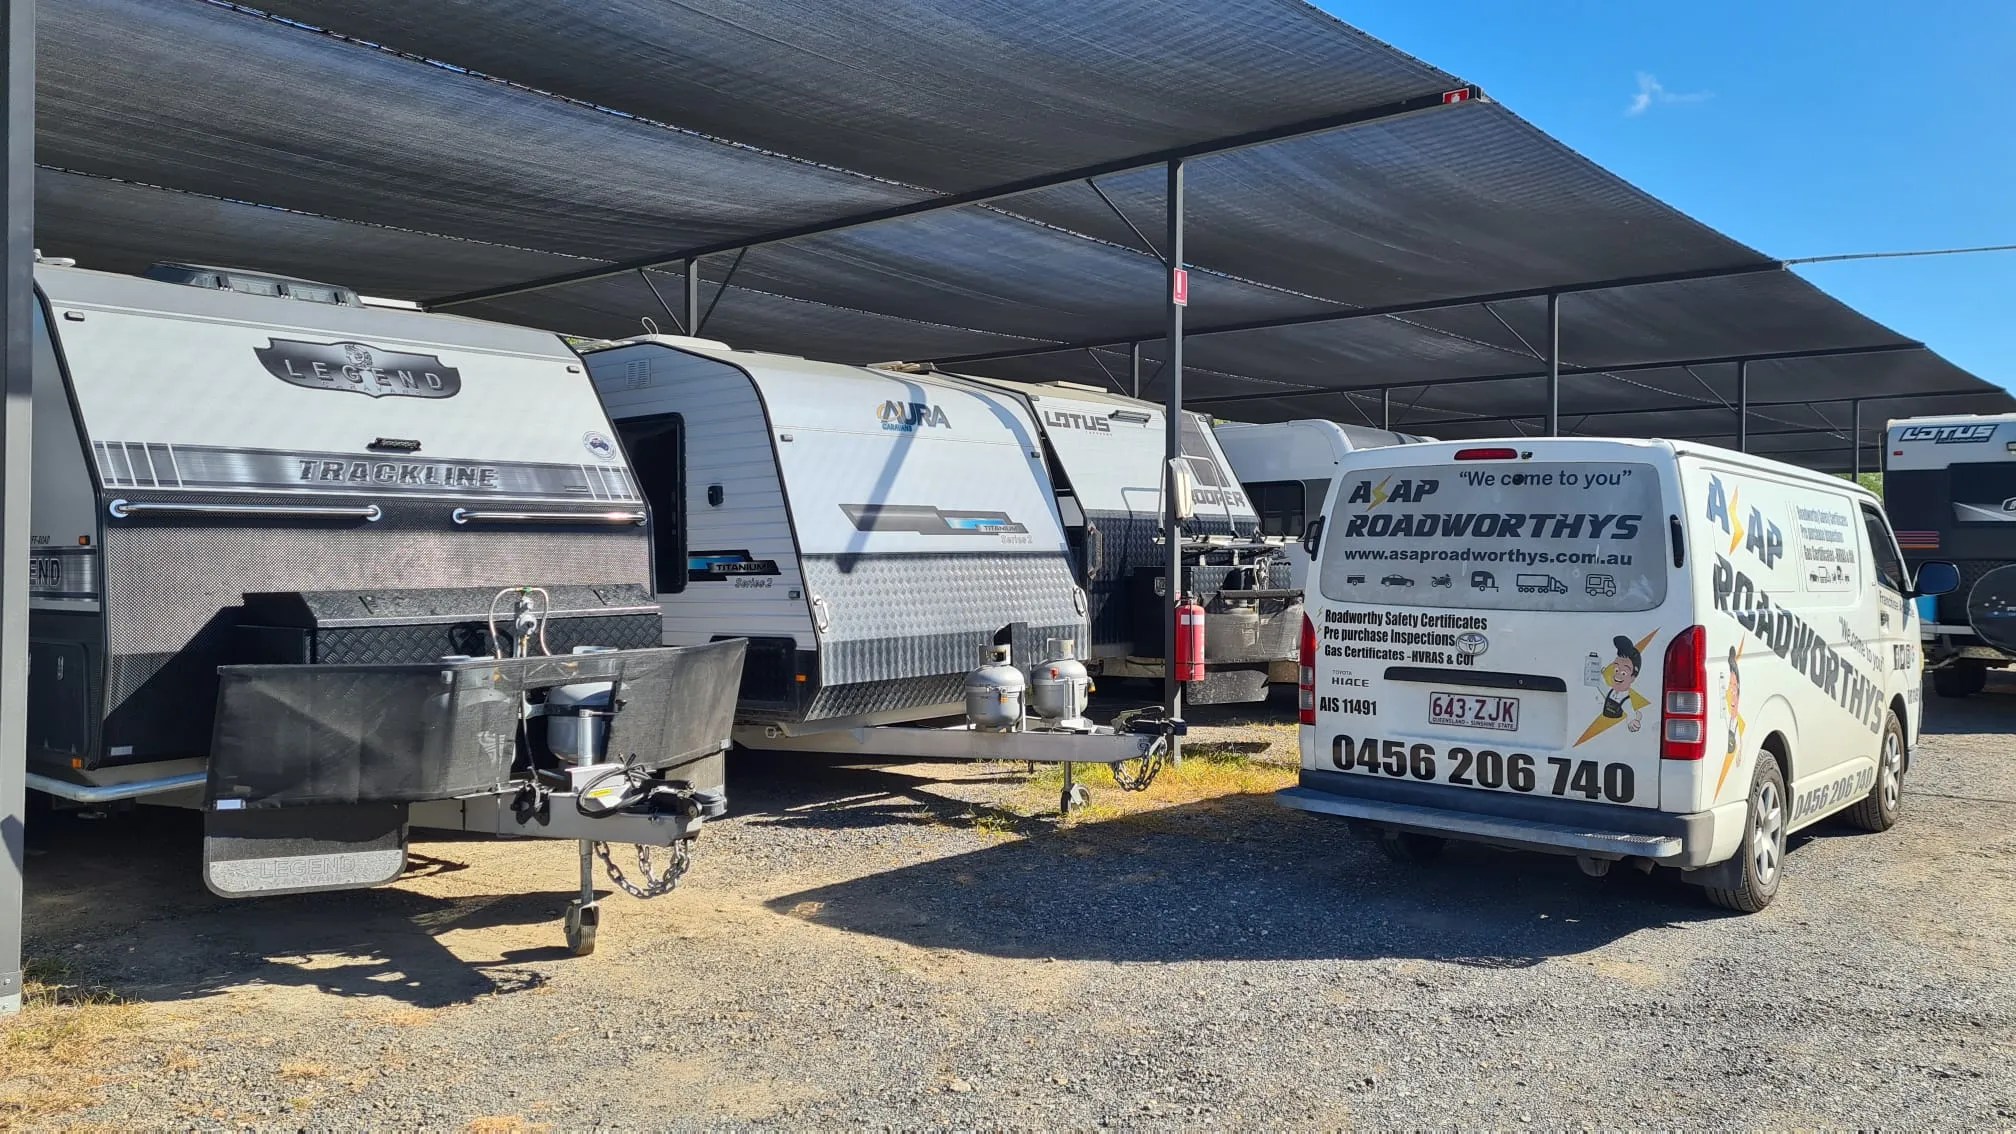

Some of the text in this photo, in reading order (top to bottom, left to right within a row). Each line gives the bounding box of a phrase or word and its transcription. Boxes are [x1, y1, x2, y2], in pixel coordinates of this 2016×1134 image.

[284, 358, 443, 391] LEGEND
[883, 400, 952, 429] AURA
[1043, 410, 1111, 432] LOTUS
[1899, 424, 1999, 442] LOTUS
[299, 460, 498, 488] TRACKLINE
[1559, 470, 1579, 486] to
[1345, 514, 1643, 539] ROADWORTHYS
[715, 563, 767, 571] TITANIUM
[1345, 548, 1633, 566] www.asaproadworthys.com.au
[1324, 609, 1488, 630] Roadworthy Safety Certificates
[1324, 626, 1456, 647] Pre purchase Inspections
[1713, 552, 1885, 735] ROADWORTHYS
[1325, 645, 1342, 657] Gas
[1344, 646, 1405, 661] Certificates
[1446, 654, 1454, 665] &
[1331, 677, 1370, 688] HIACE
[1320, 697, 1377, 716] AIS 11491
[1332, 734, 1635, 803] 0456 206 740
[1793, 765, 1875, 821] 0456 206 740
[259, 856, 356, 879] LEGEND
